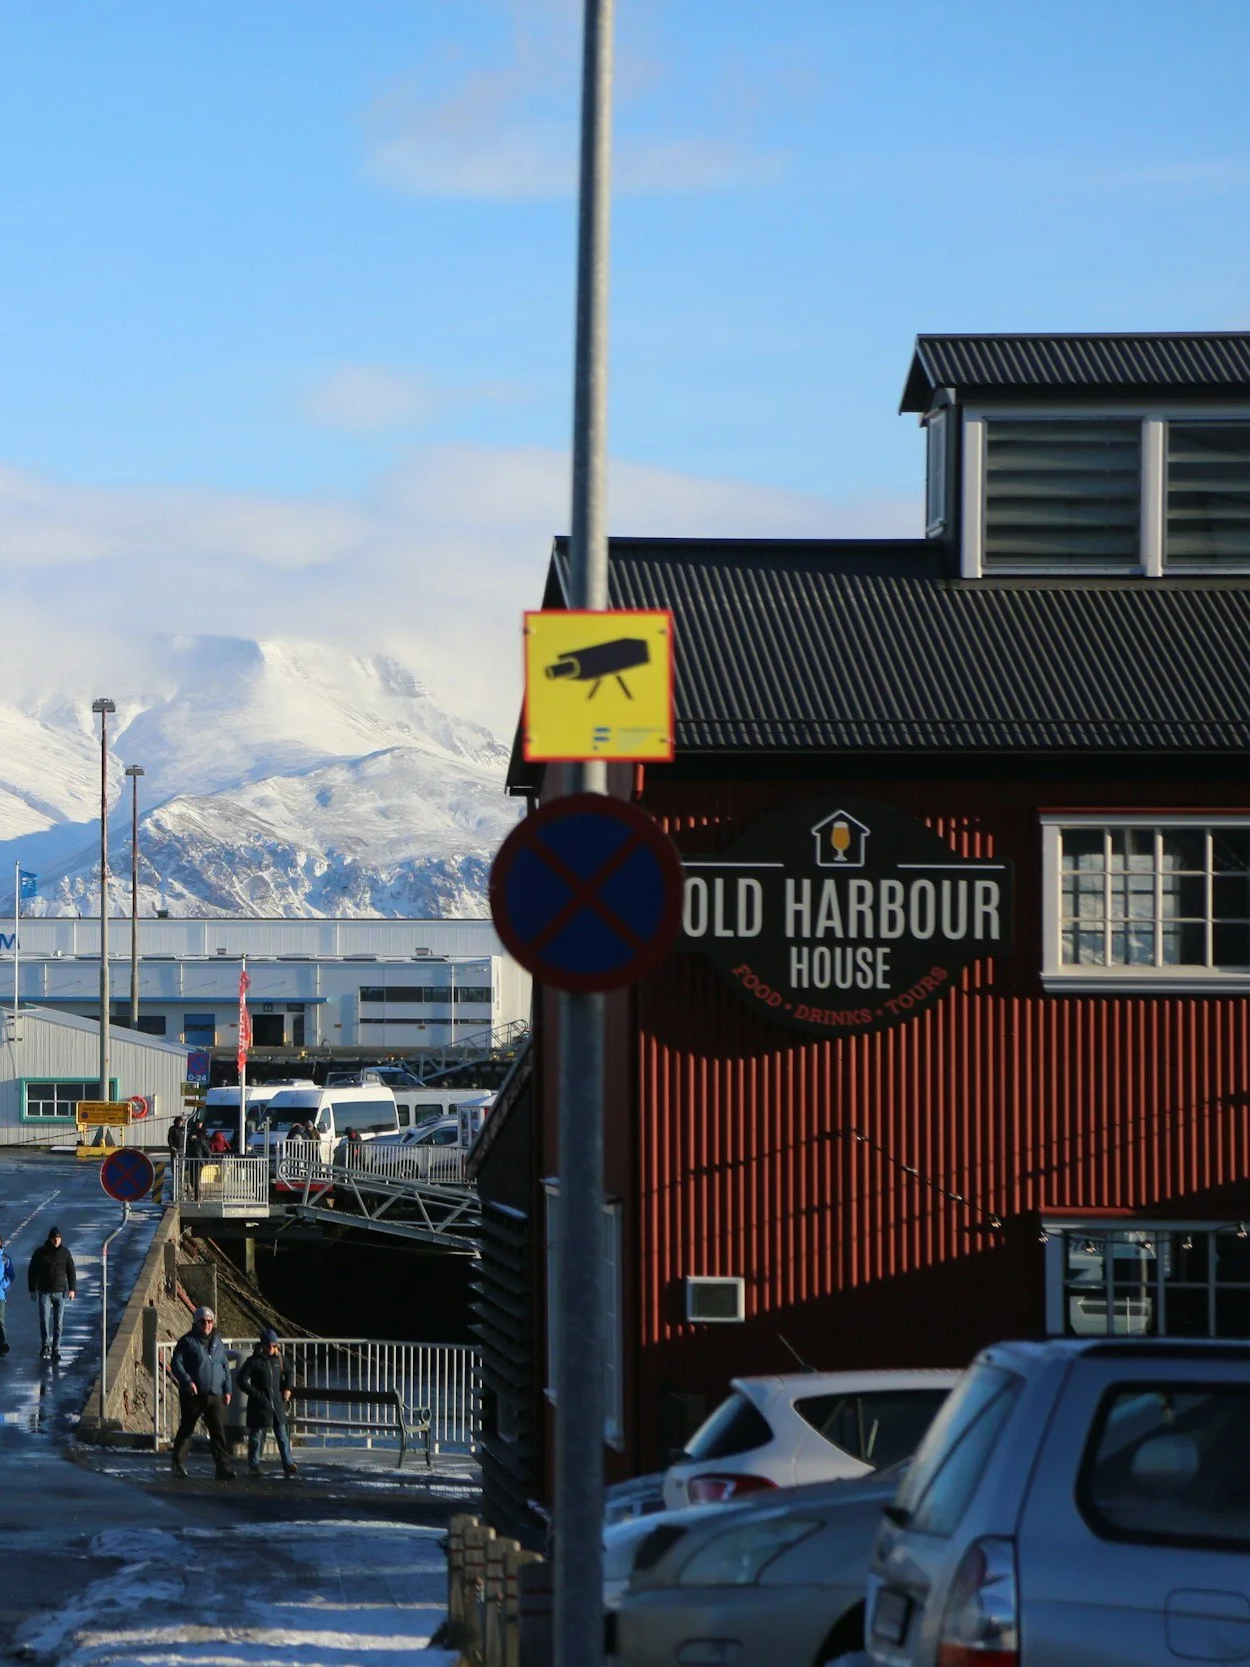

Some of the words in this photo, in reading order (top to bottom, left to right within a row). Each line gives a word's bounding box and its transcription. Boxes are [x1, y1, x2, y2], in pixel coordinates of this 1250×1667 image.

[682, 877, 763, 938] OLD
[785, 878, 1001, 941] HARBOUR
[731, 963, 784, 1009] FOOD
[794, 1006, 873, 1026] DRINKS
[884, 965, 950, 1016] TOURS
[790, 946, 892, 990] HOUSE
[188, 1074, 207, 1082] 0-24
